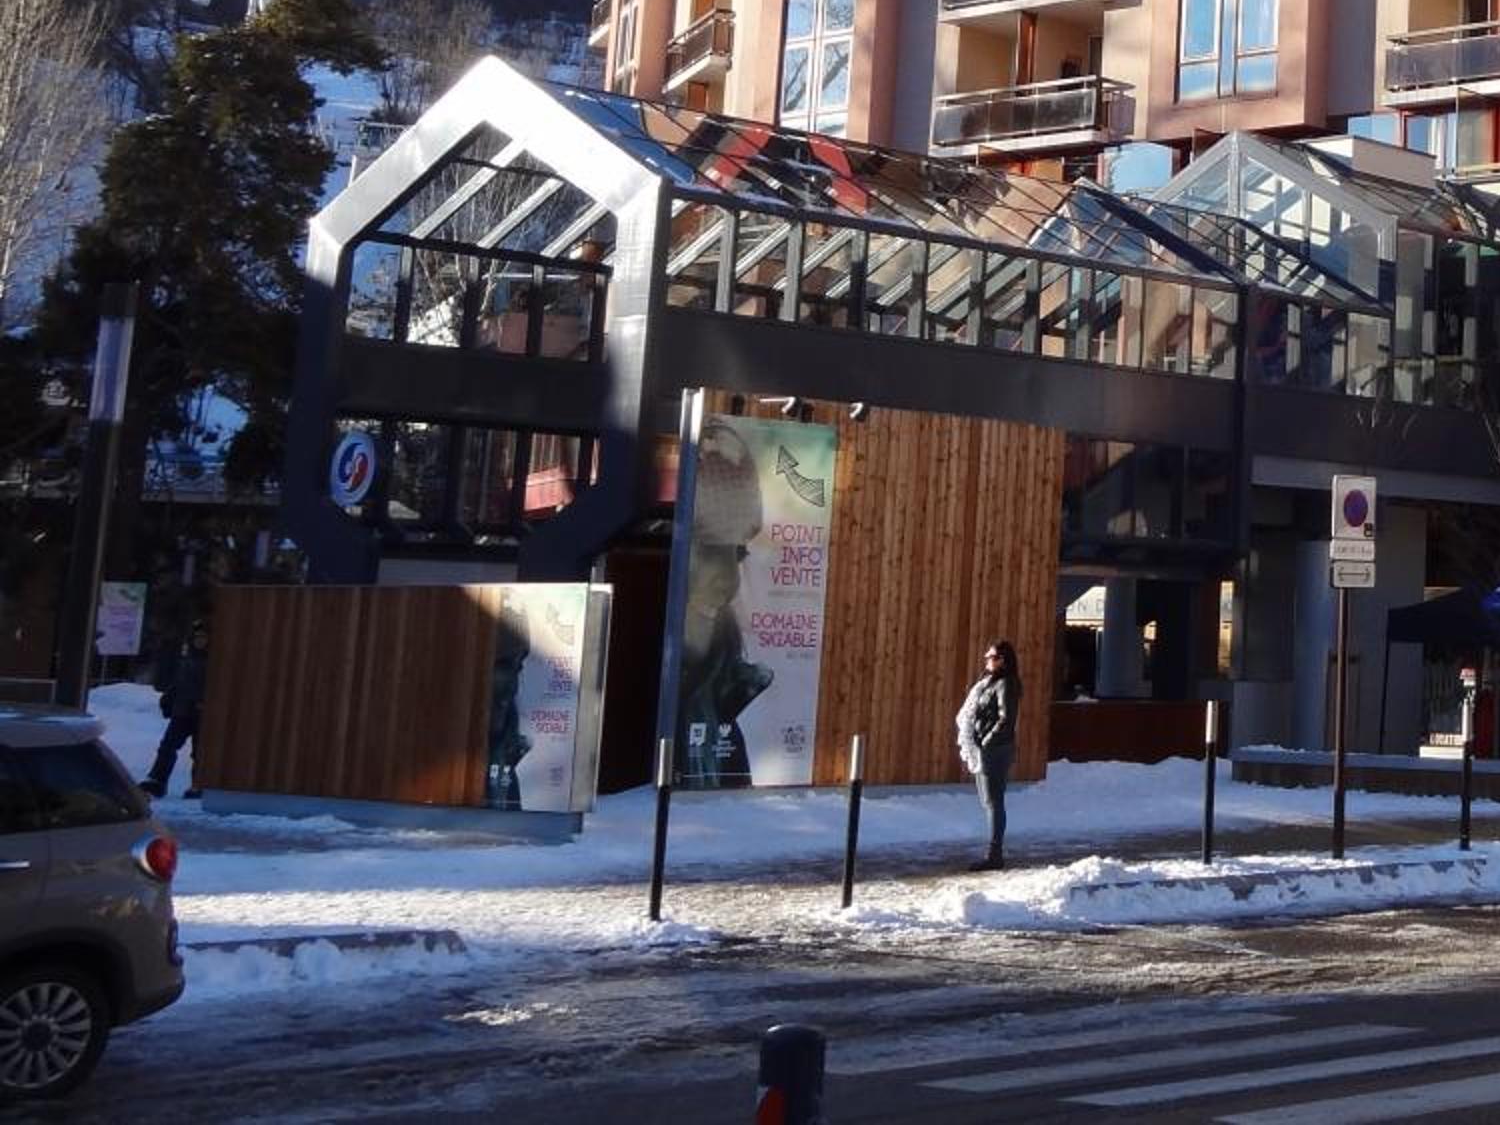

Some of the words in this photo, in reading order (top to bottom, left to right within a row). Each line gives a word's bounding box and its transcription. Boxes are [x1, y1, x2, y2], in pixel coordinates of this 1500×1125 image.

[771, 524, 824, 544] POINT
[781, 546, 822, 566] INFO
[770, 567, 821, 587] VENTE
[751, 612, 817, 630] DOMAINE
[758, 631, 817, 648] SKIABLE
